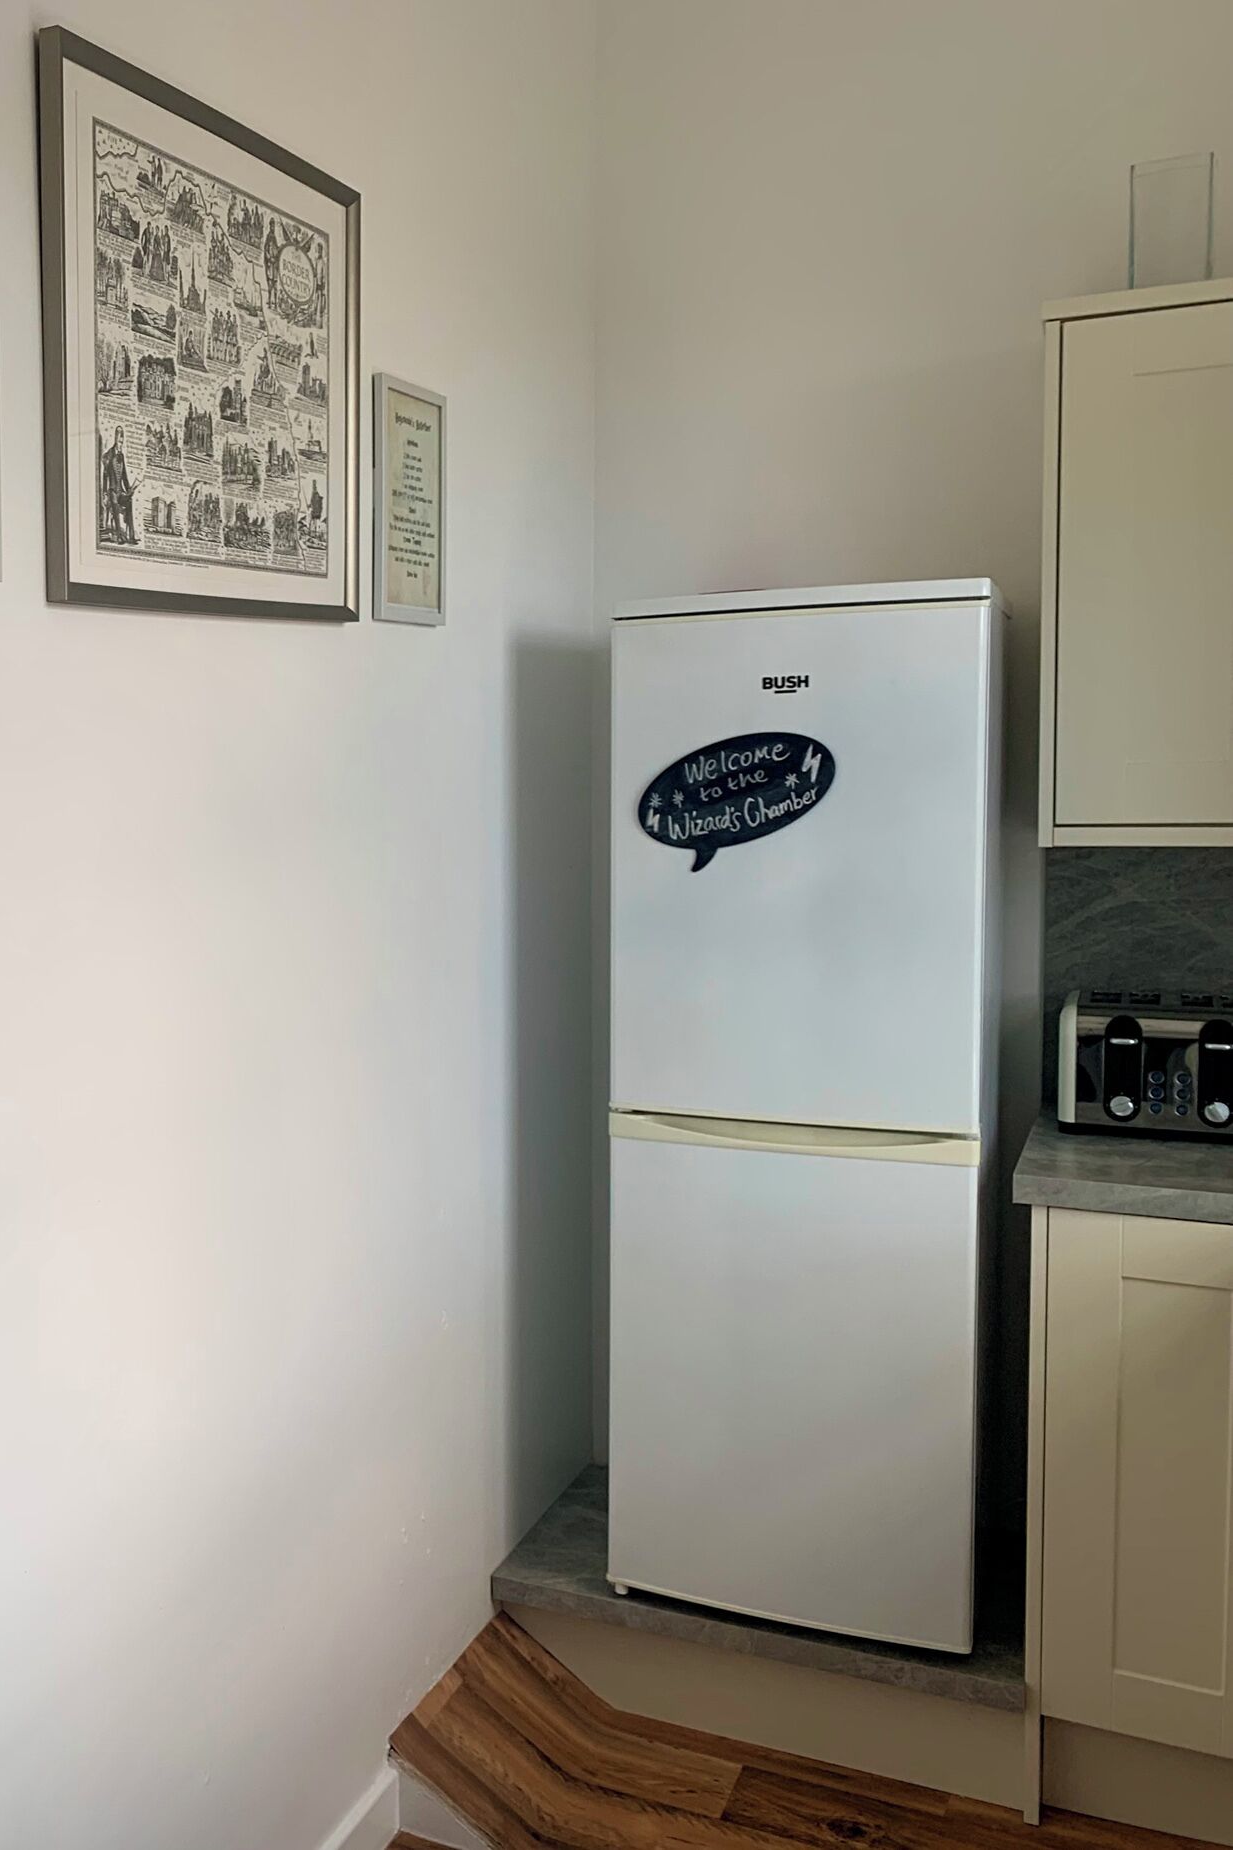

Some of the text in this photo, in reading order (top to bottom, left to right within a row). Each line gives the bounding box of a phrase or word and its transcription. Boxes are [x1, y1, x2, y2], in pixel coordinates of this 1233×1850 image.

[282, 258, 310, 281] BORDER
[761, 675, 810, 690] BUSH
[684, 742, 791, 785] Welcome
[699, 769, 770, 803] to the
[667, 786, 819, 841] Wizard's Chamber
